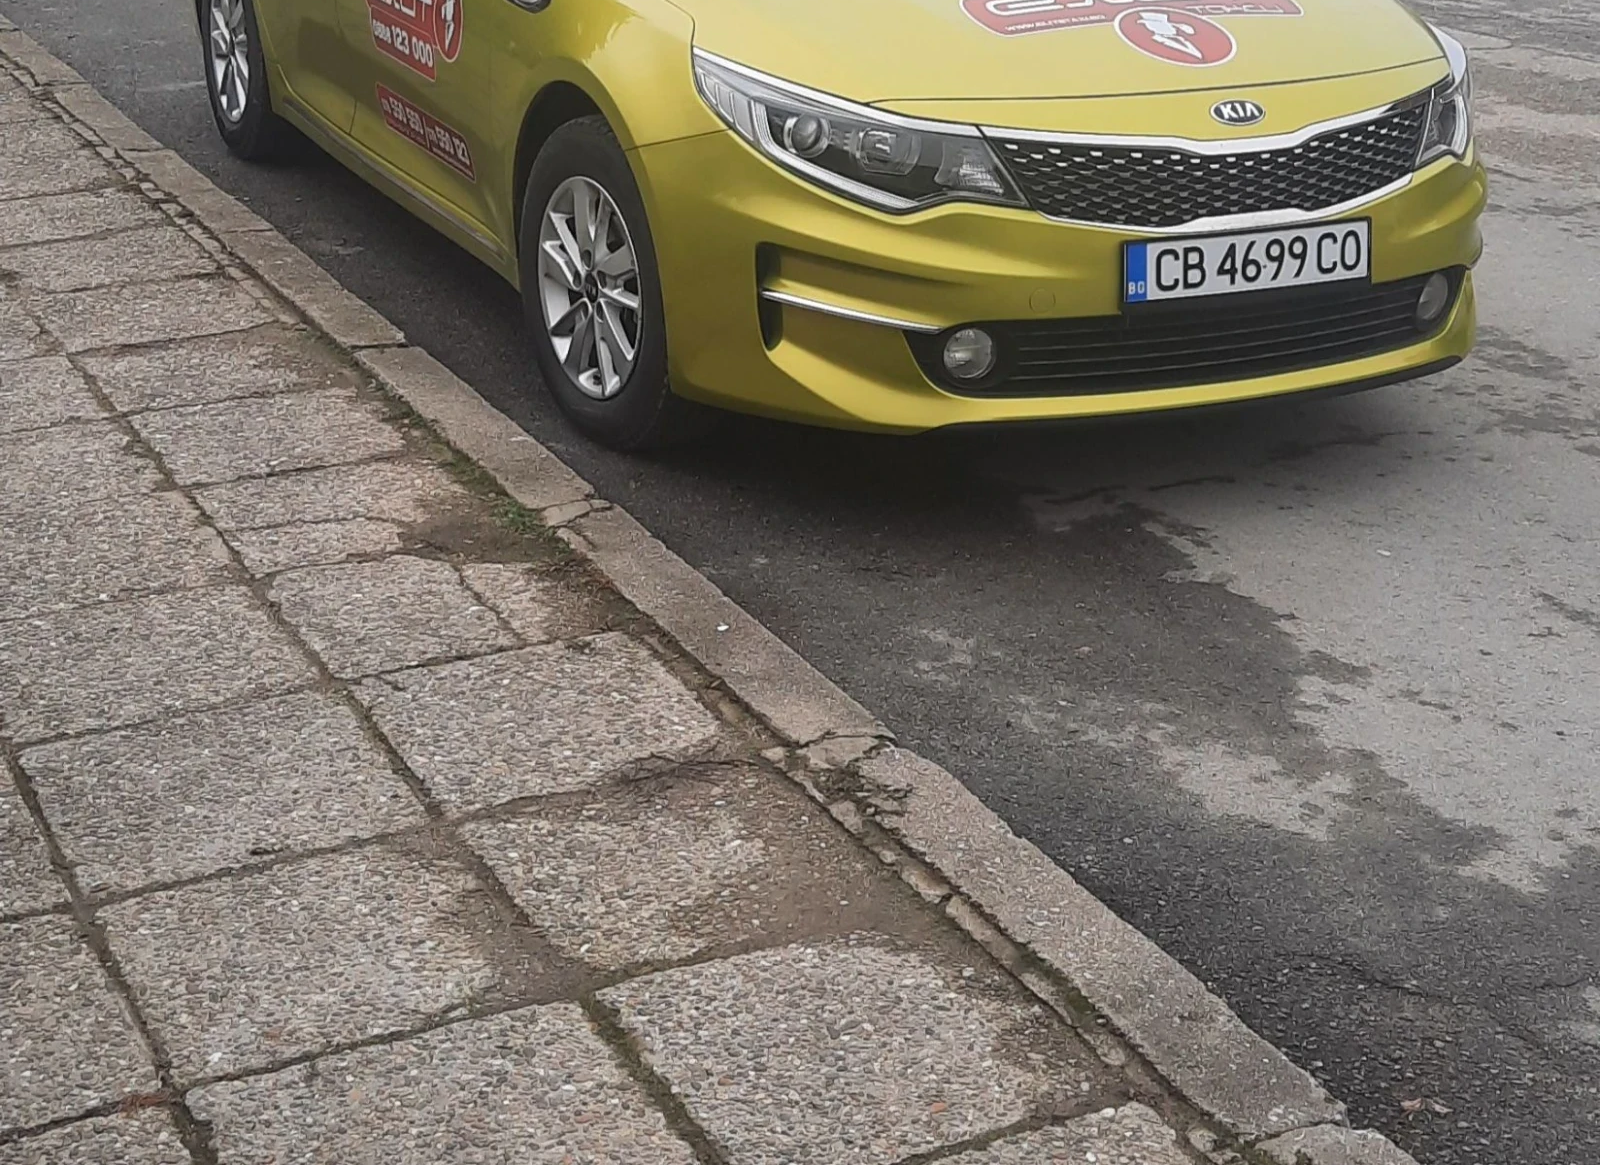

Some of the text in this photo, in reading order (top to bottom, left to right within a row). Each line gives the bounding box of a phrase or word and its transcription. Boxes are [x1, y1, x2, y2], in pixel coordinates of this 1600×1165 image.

[412, 36, 433, 68] 000
[1219, 102, 1260, 120] KIA
[1216, 236, 1308, 285] 4699
